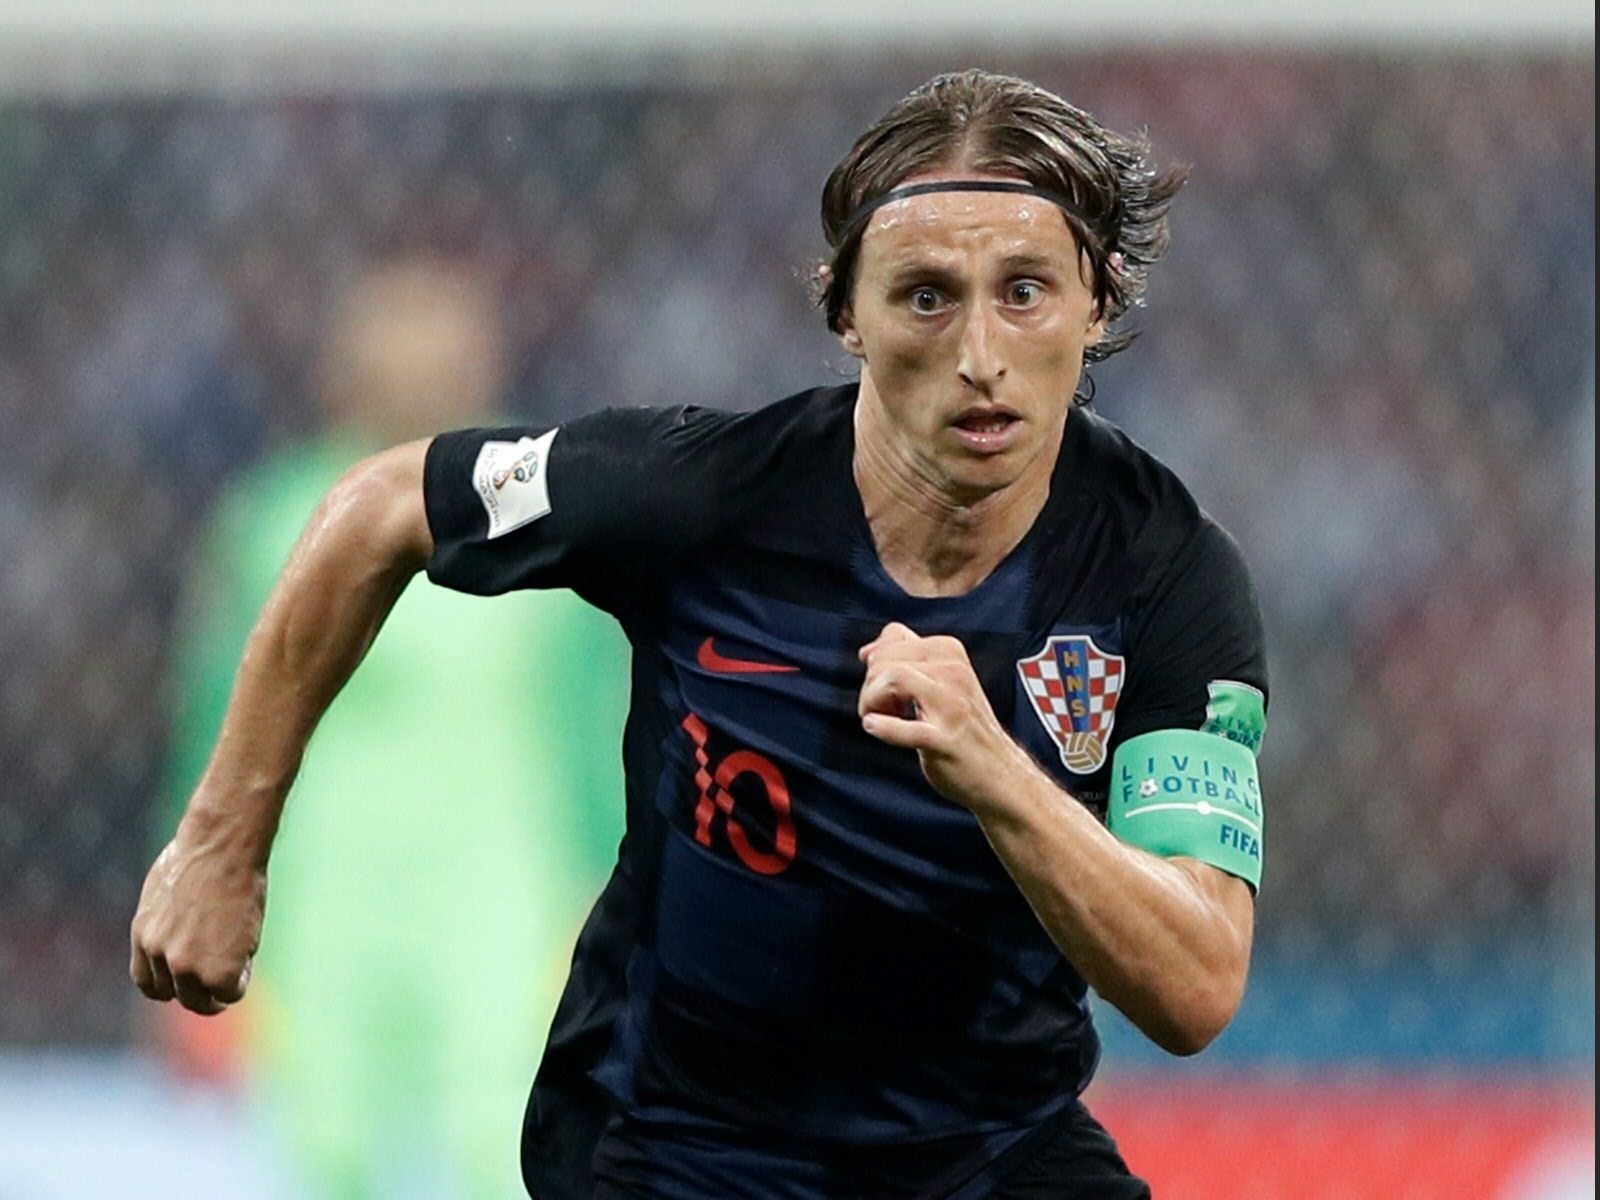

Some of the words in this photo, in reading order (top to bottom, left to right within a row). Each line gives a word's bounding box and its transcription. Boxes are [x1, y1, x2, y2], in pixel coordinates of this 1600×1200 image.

[1063, 650, 1086, 718] HNS
[682, 712, 796, 875] 10
[1122, 756, 1258, 796] LIVING
[1219, 824, 1260, 862] FIFA
